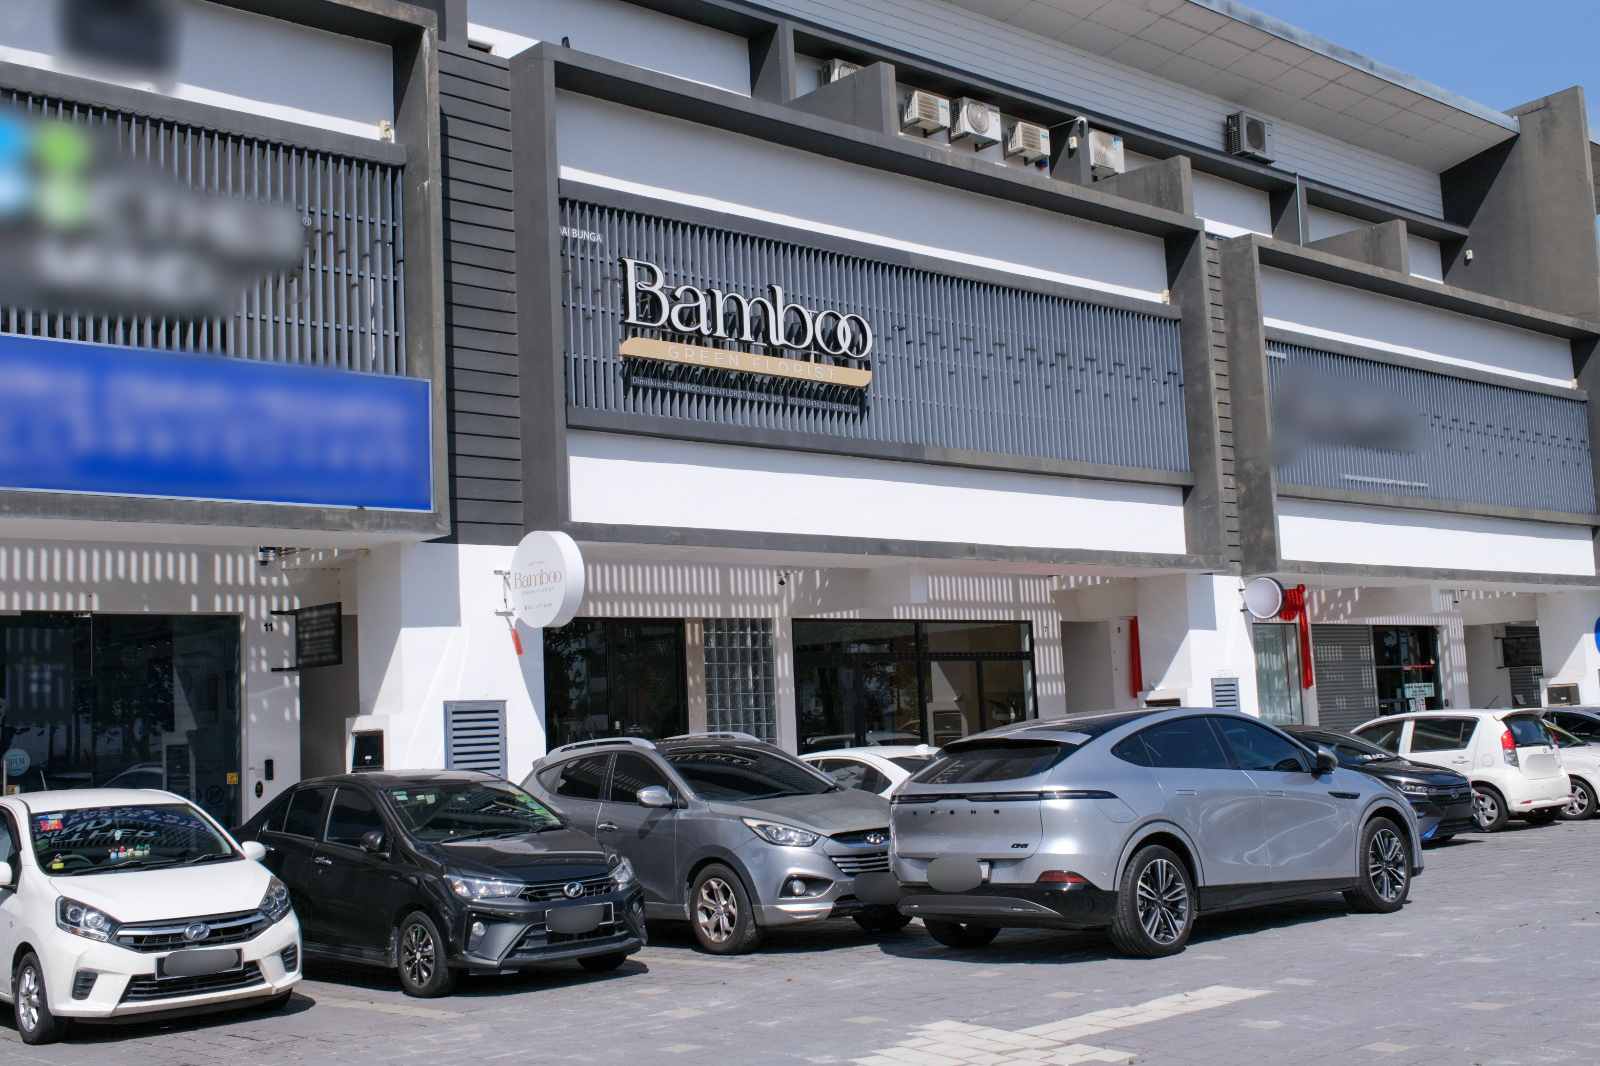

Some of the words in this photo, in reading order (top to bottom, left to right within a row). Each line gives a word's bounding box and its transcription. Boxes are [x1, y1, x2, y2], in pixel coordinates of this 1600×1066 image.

[571, 228, 602, 242] BUNGA
[619, 256, 873, 359] Bamboo
[668, 345, 740, 367] GREEN
[752, 357, 837, 380] FLORIST
[673, 382, 700, 392] BAMBOO
[701, 386, 721, 395] GREEN
[722, 389, 746, 398] FLORIST
[514, 568, 562, 589] Bamboo
[263, 622, 273, 632] 11
